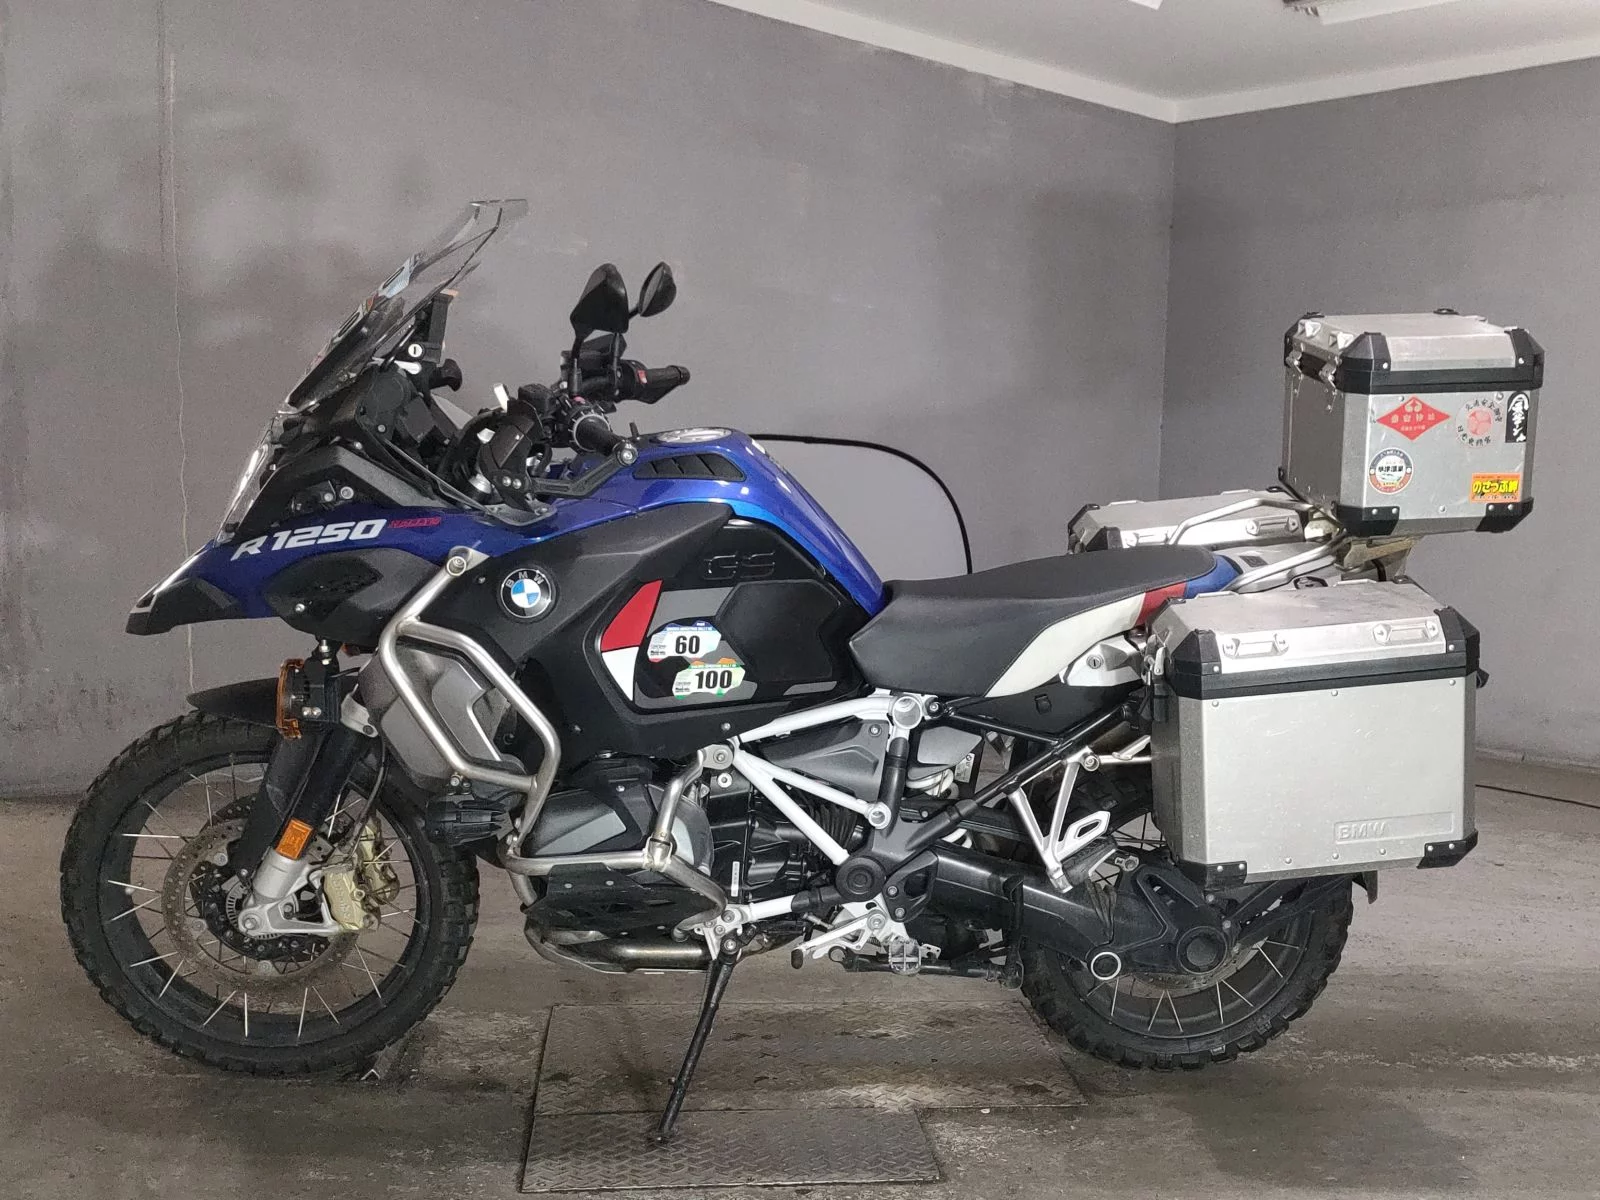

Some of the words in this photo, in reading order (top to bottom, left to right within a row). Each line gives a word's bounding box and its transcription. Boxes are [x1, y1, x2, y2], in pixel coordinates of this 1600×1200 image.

[230, 535, 267, 562] R
[271, 518, 388, 551] 1250
[505, 570, 544, 589] BMW
[675, 635, 700, 655] 60
[695, 670, 733, 689] 100
[1338, 821, 1387, 839] BMW
